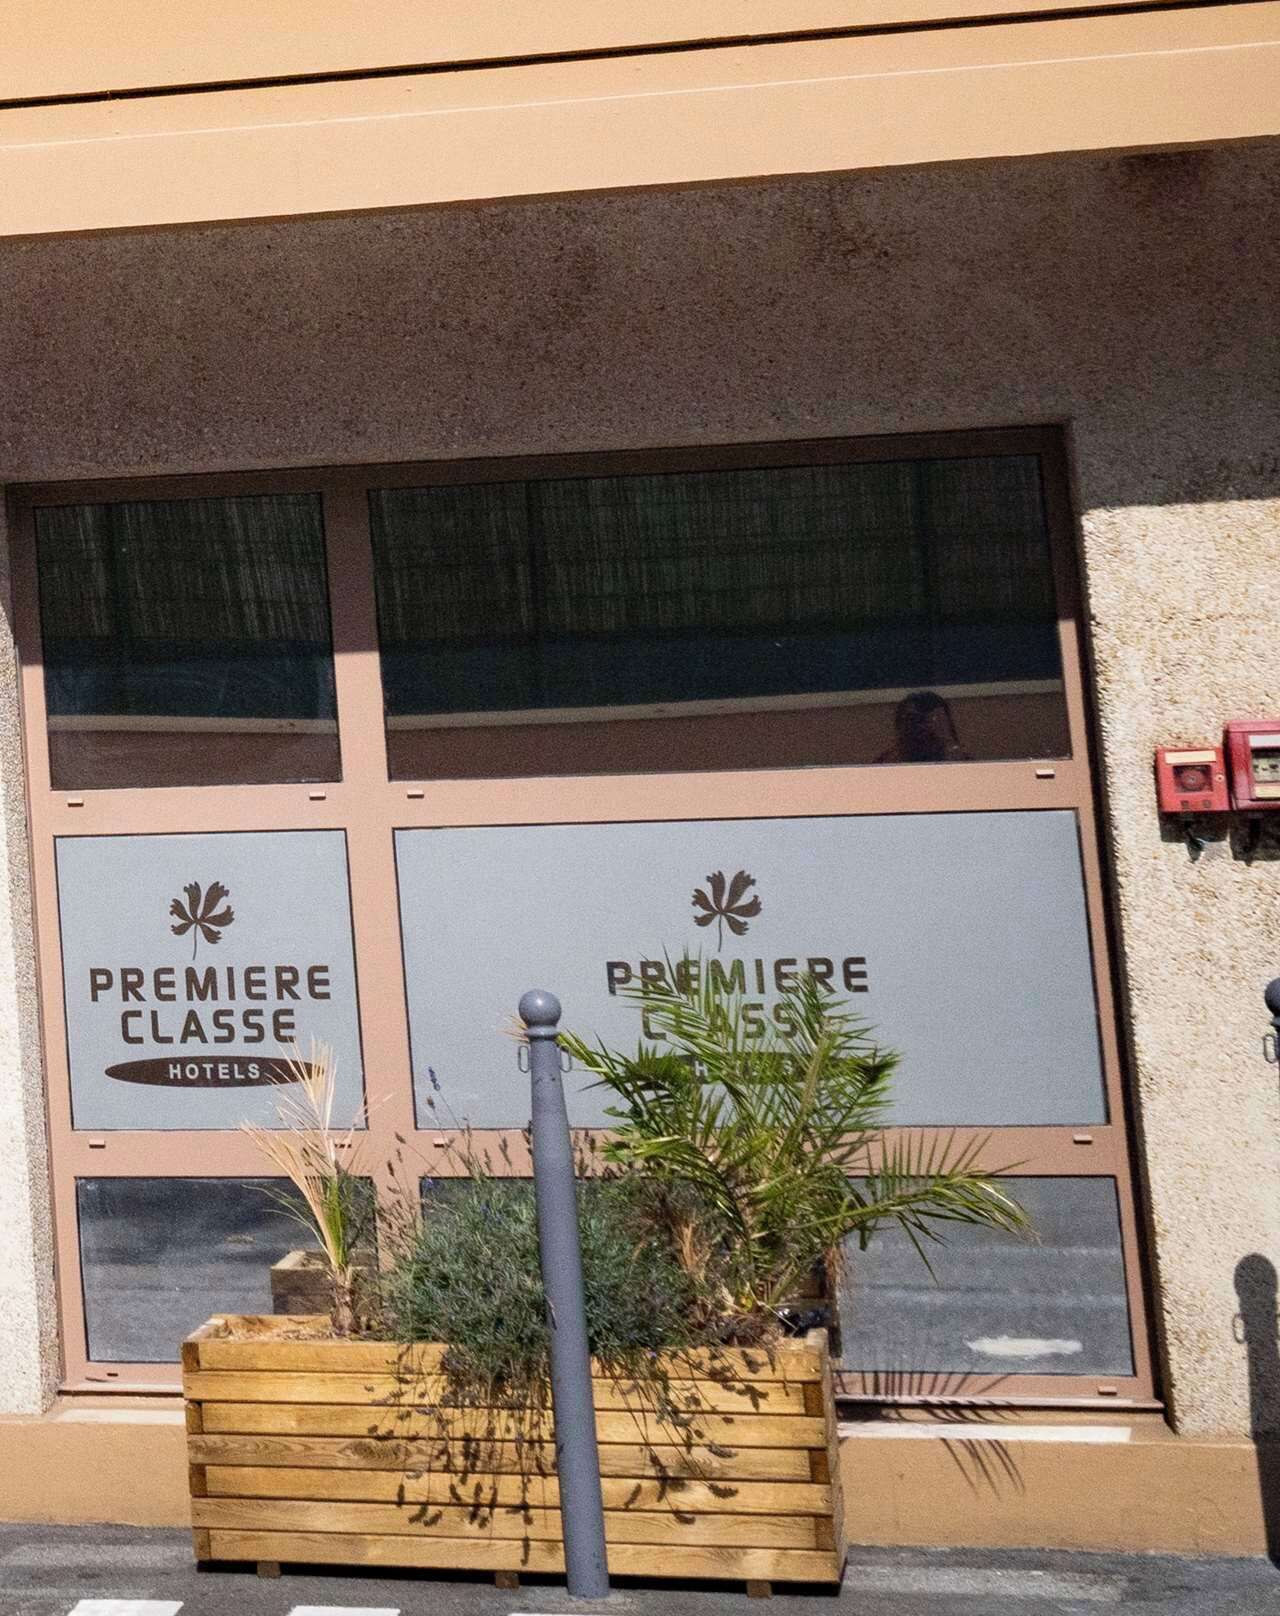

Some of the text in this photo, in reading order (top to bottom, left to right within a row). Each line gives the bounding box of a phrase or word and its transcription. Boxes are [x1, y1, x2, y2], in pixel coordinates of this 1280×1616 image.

[89, 965, 331, 1003] PREMIERE
[605, 957, 870, 996] PREMIERE
[120, 1009, 297, 1045] CLASSE
[168, 1063, 262, 1080] HOTELS
